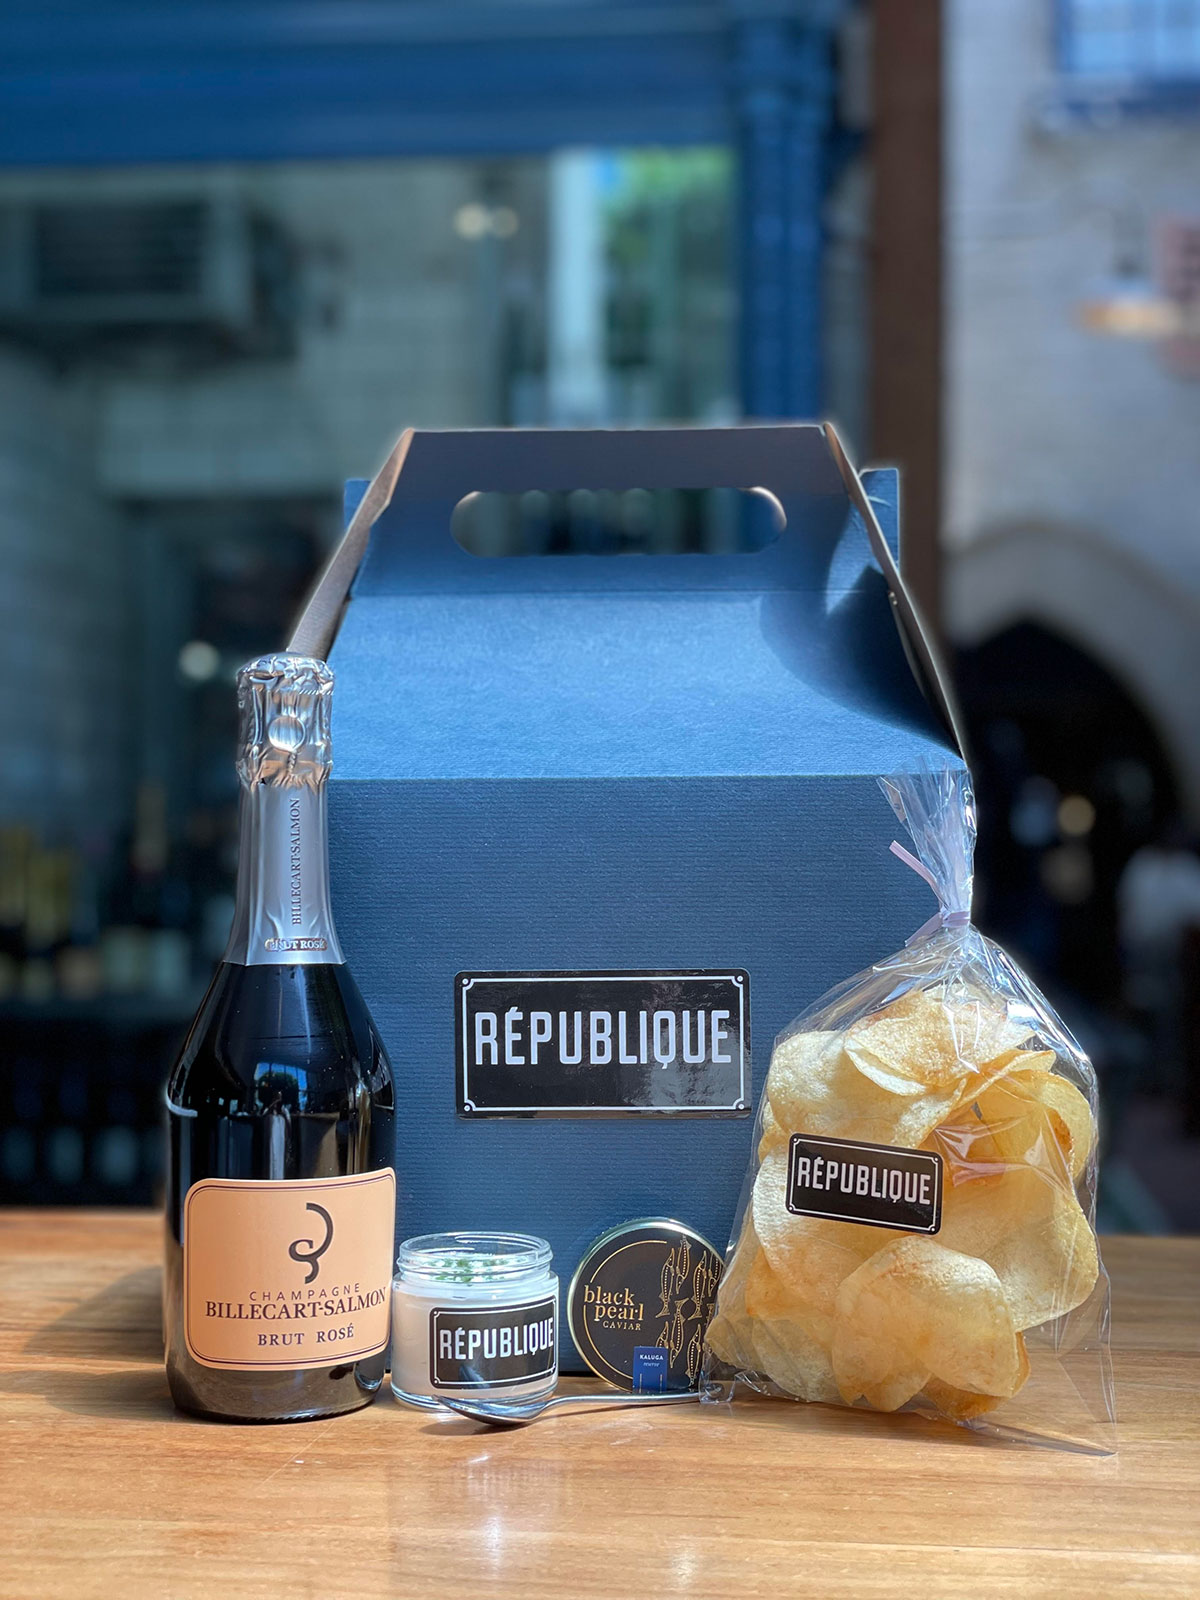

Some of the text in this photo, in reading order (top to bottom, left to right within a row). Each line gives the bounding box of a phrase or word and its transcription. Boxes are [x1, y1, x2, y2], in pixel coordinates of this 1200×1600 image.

[474, 1006, 732, 1069] RÉPUBLIQUE
[797, 1156, 932, 1206] RÉPUBLIQUE
[205, 1287, 387, 1320] BILLECART-SALMON
[249, 1282, 361, 1301] CHAMPAGNE
[584, 1285, 635, 1306] black
[594, 1303, 644, 1322] pearl
[257, 1322, 355, 1346] BRUT ROSÉ
[602, 1320, 642, 1331] CAVIAR
[439, 1317, 554, 1360] RÉPUBLIQUE
